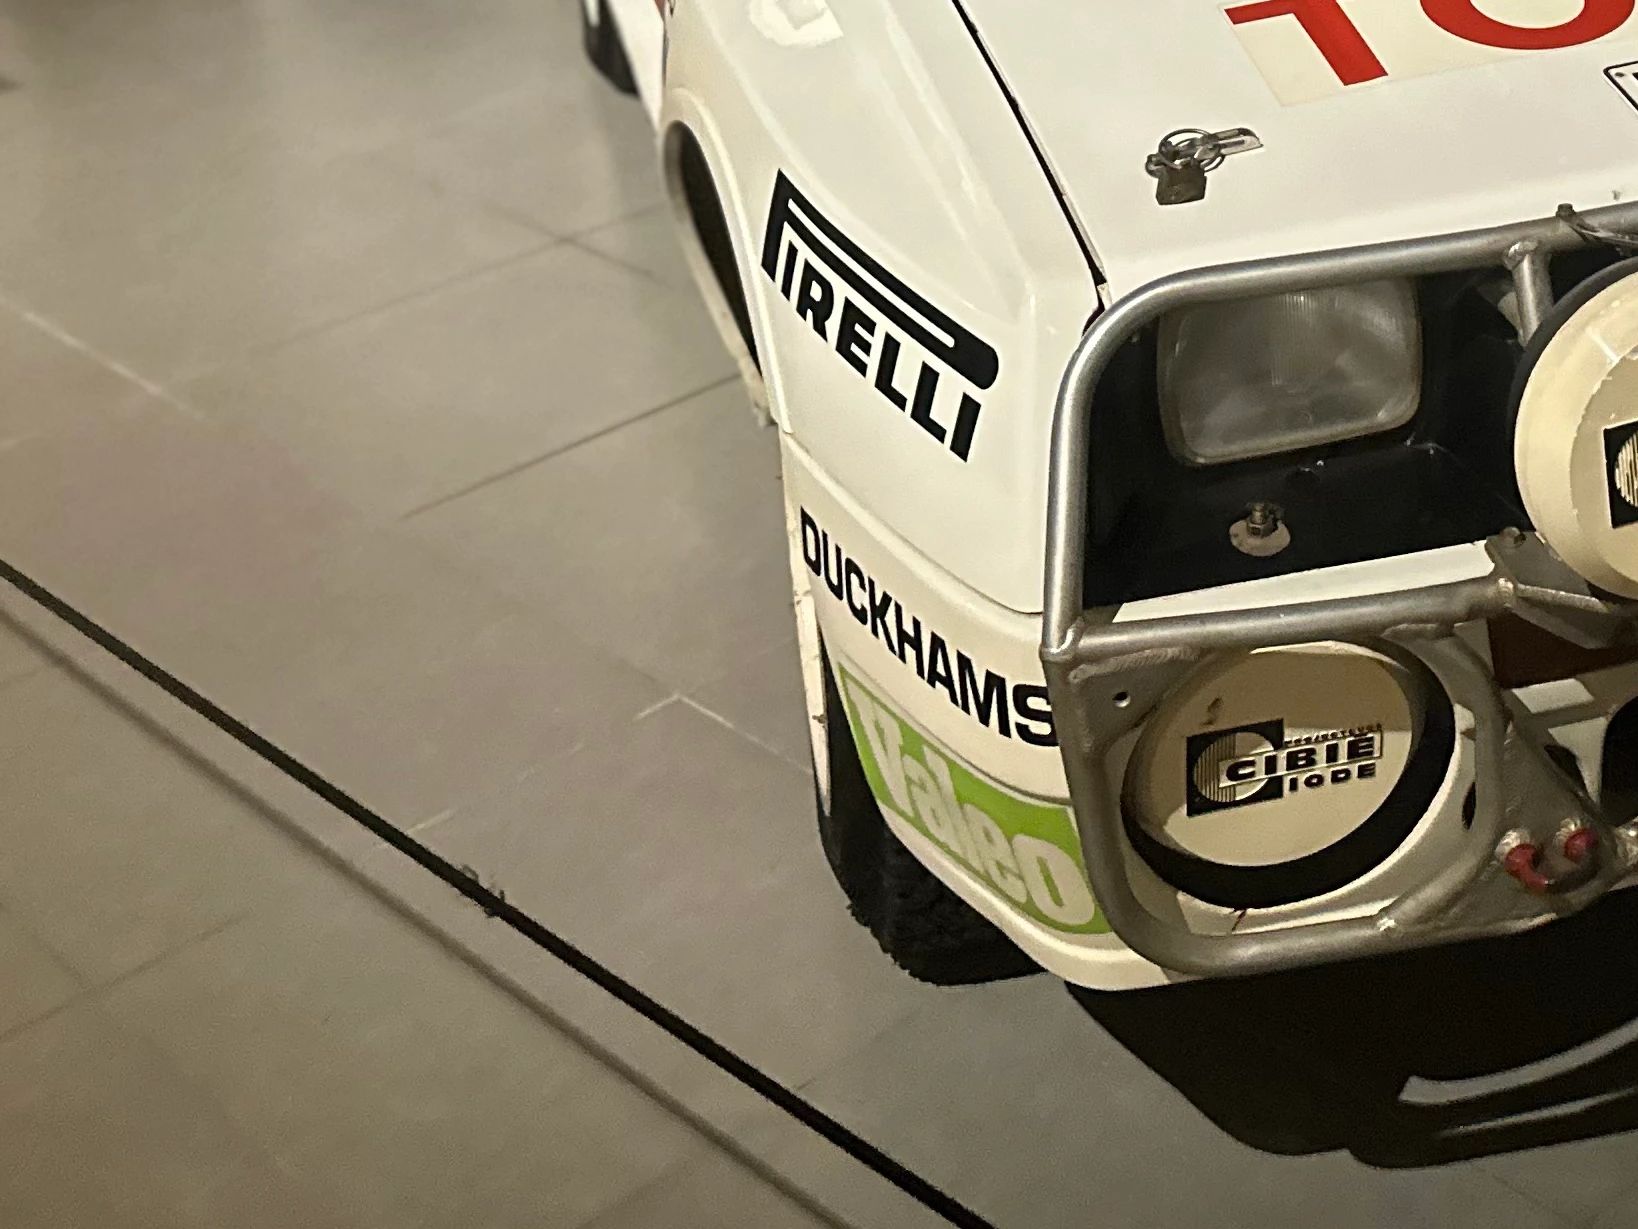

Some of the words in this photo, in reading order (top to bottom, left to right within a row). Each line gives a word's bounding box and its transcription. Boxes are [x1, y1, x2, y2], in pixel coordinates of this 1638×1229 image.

[761, 168, 1000, 462] PIRELLI
[800, 505, 1060, 748] DUCKHAMS
[842, 675, 1096, 926] Valeo
[1288, 761, 1377, 792] IODE
